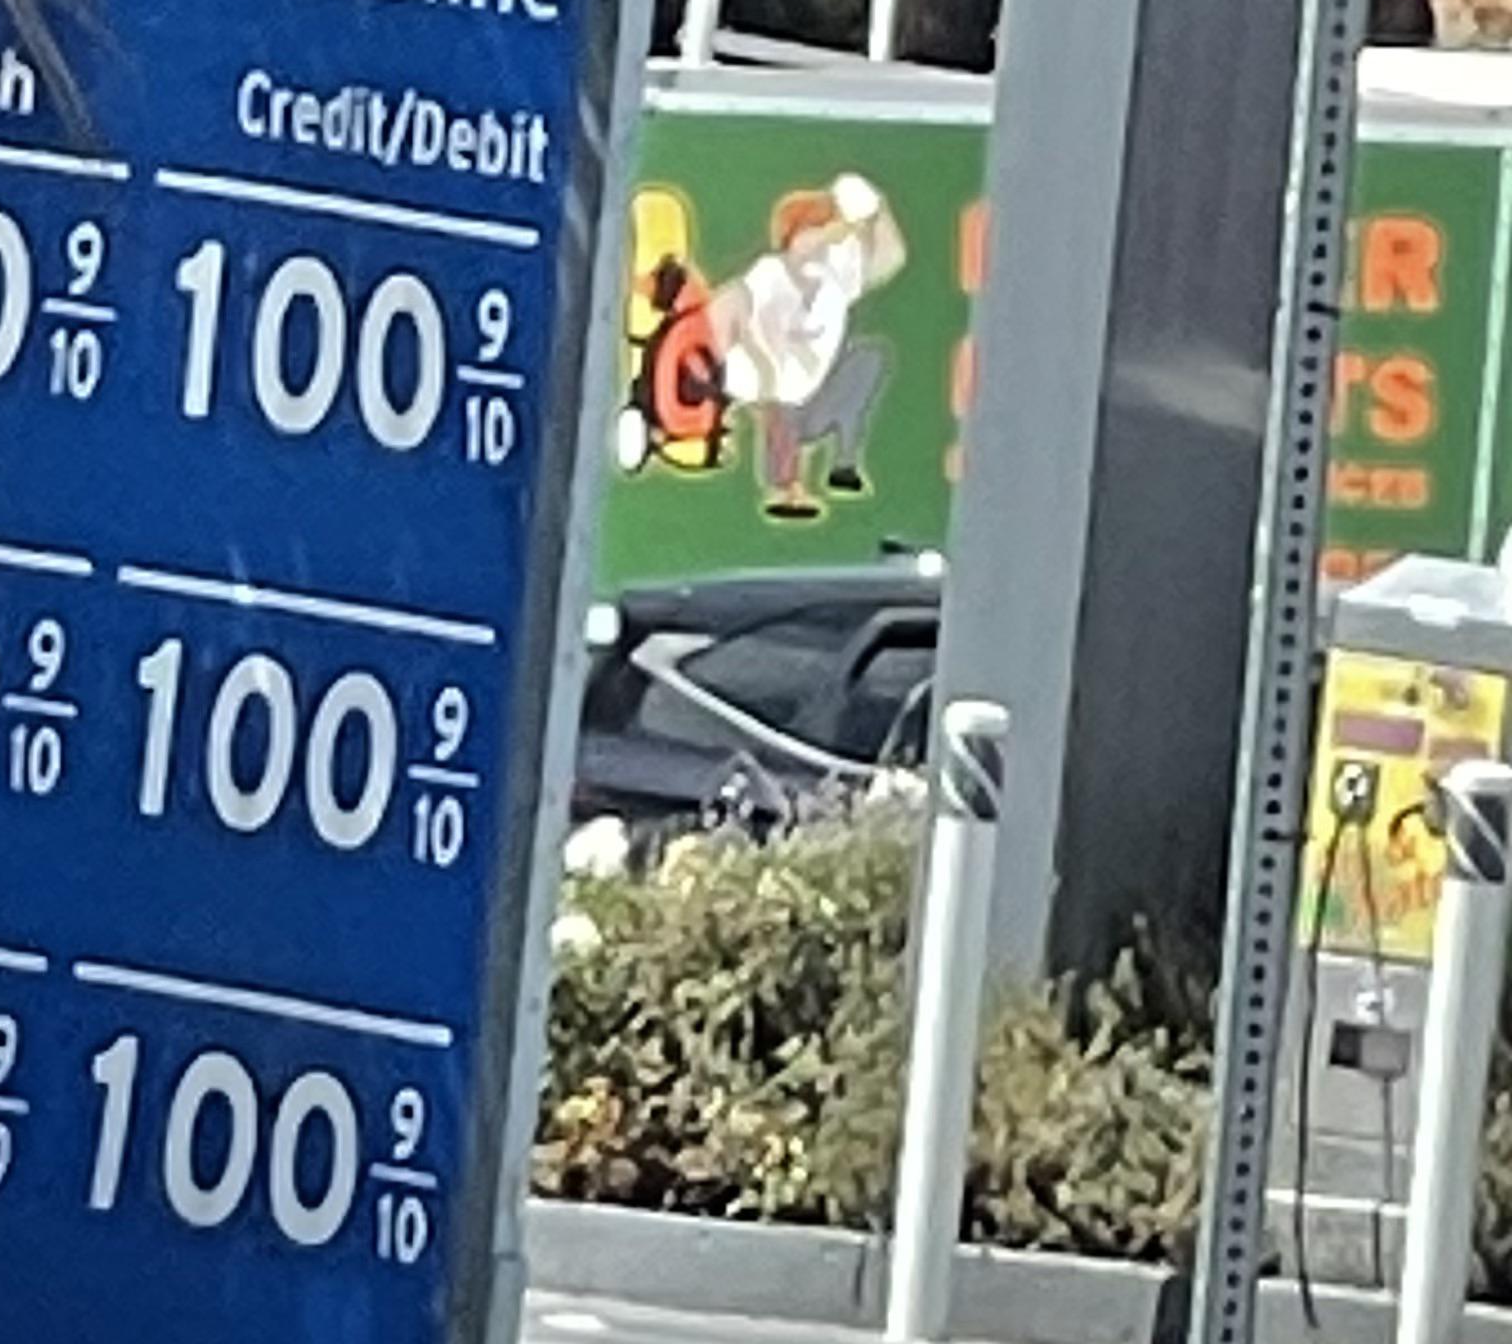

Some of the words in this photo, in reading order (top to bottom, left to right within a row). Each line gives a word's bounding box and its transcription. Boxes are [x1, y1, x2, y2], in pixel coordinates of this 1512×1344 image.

[238, 70, 549, 185] Credit/Debit
[176, 240, 445, 451] 100
[138, 638, 397, 849] 100
[91, 1036, 358, 1246] 100
